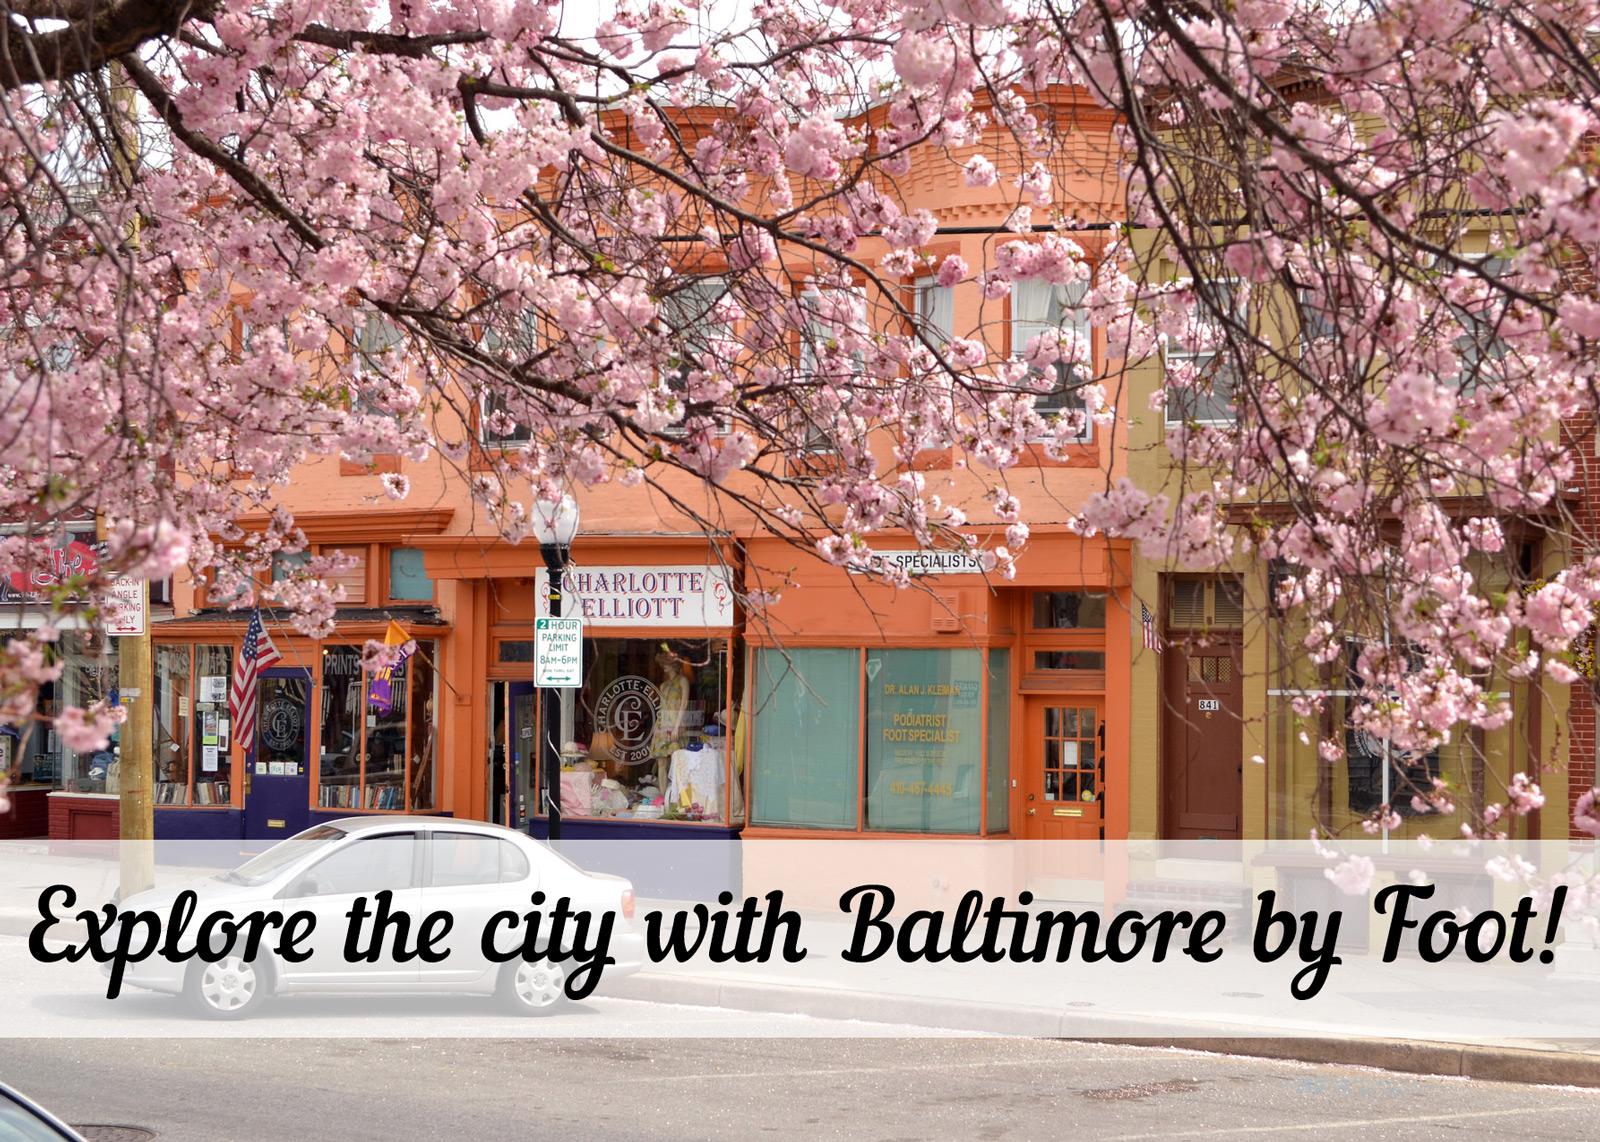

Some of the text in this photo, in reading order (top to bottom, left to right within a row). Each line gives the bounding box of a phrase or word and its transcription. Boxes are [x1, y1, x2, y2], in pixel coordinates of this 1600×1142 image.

[896, 554, 977, 568] SPECIALISTS
[563, 572, 704, 595] CHARLOTTE
[111, 590, 138, 599] ANGLE
[119, 602, 142, 612] RKING
[581, 597, 685, 619] ELLIOTT
[121, 615, 136, 624] NLY
[539, 619, 578, 630] 2 HOUR
[541, 633, 578, 642] PARKING
[549, 643, 569, 652] LIMIT
[324, 654, 360, 676] PRINTS
[539, 655, 578, 665] 8AM-6PM
[898, 684, 920, 696] ALAN
[1199, 700, 1217, 710] 841
[893, 713, 947, 728] PODIATRIST
[883, 729, 960, 743] FOOT SPECIALIST
